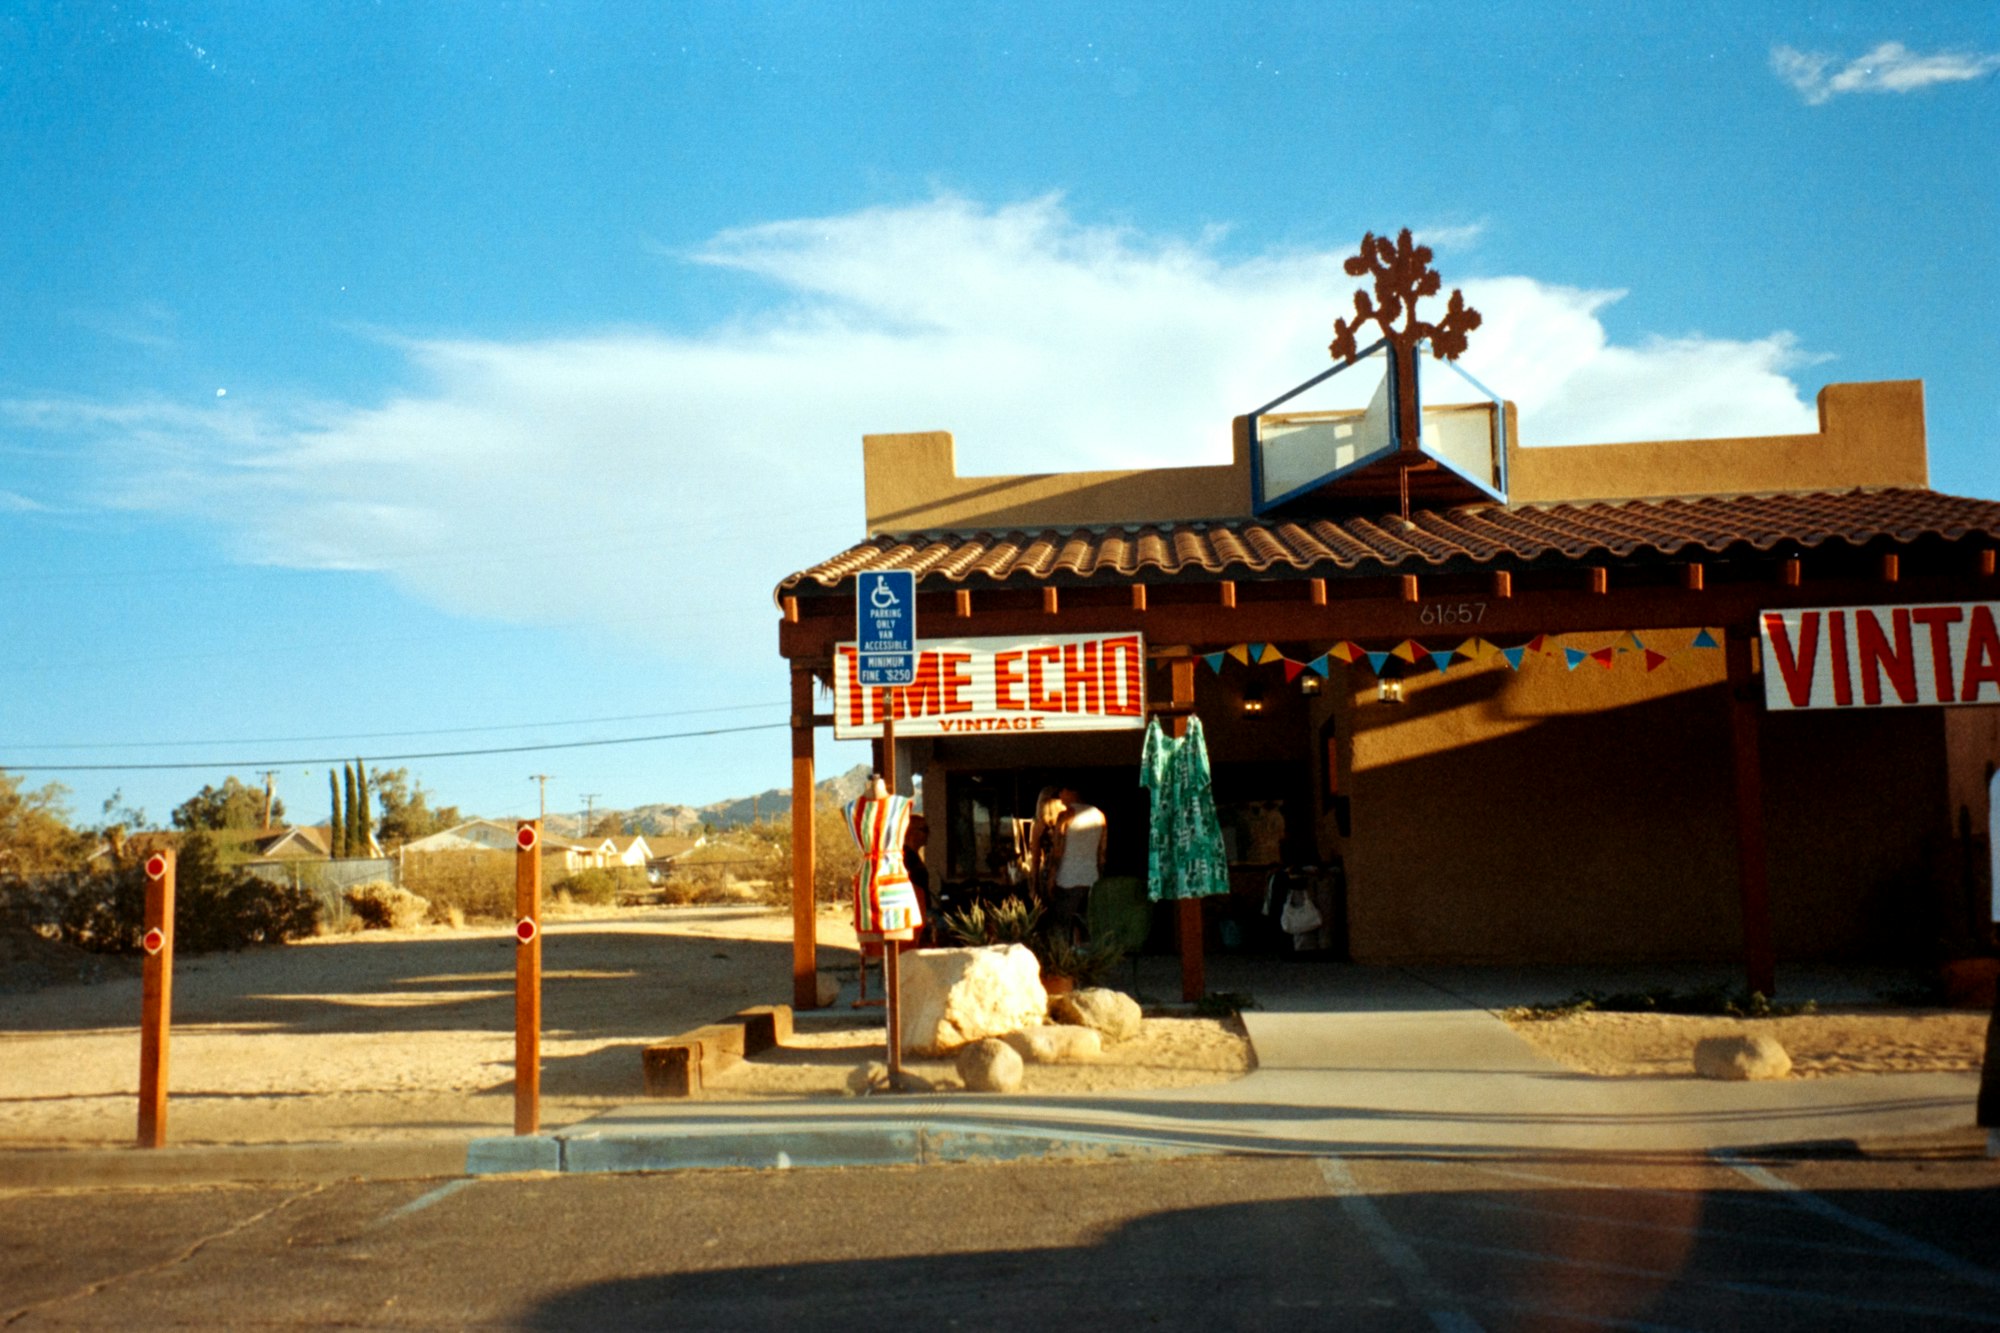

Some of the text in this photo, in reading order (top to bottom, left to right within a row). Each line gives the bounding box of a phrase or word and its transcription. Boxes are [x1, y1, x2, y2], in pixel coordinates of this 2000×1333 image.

[870, 609, 902, 618] PARKING
[1420, 603, 1487, 625] 61657
[876, 619, 895, 629] ONLY
[879, 630, 893, 639] VAN
[864, 641, 907, 651] ACCESSIBLE
[1763, 605, 2000, 706] VINTA
[868, 656, 904, 667] MINIMUM
[862, 670, 880, 681] FINE
[995, 635, 1141, 717] ECHO
[938, 716, 1044, 732] VINTAGE
